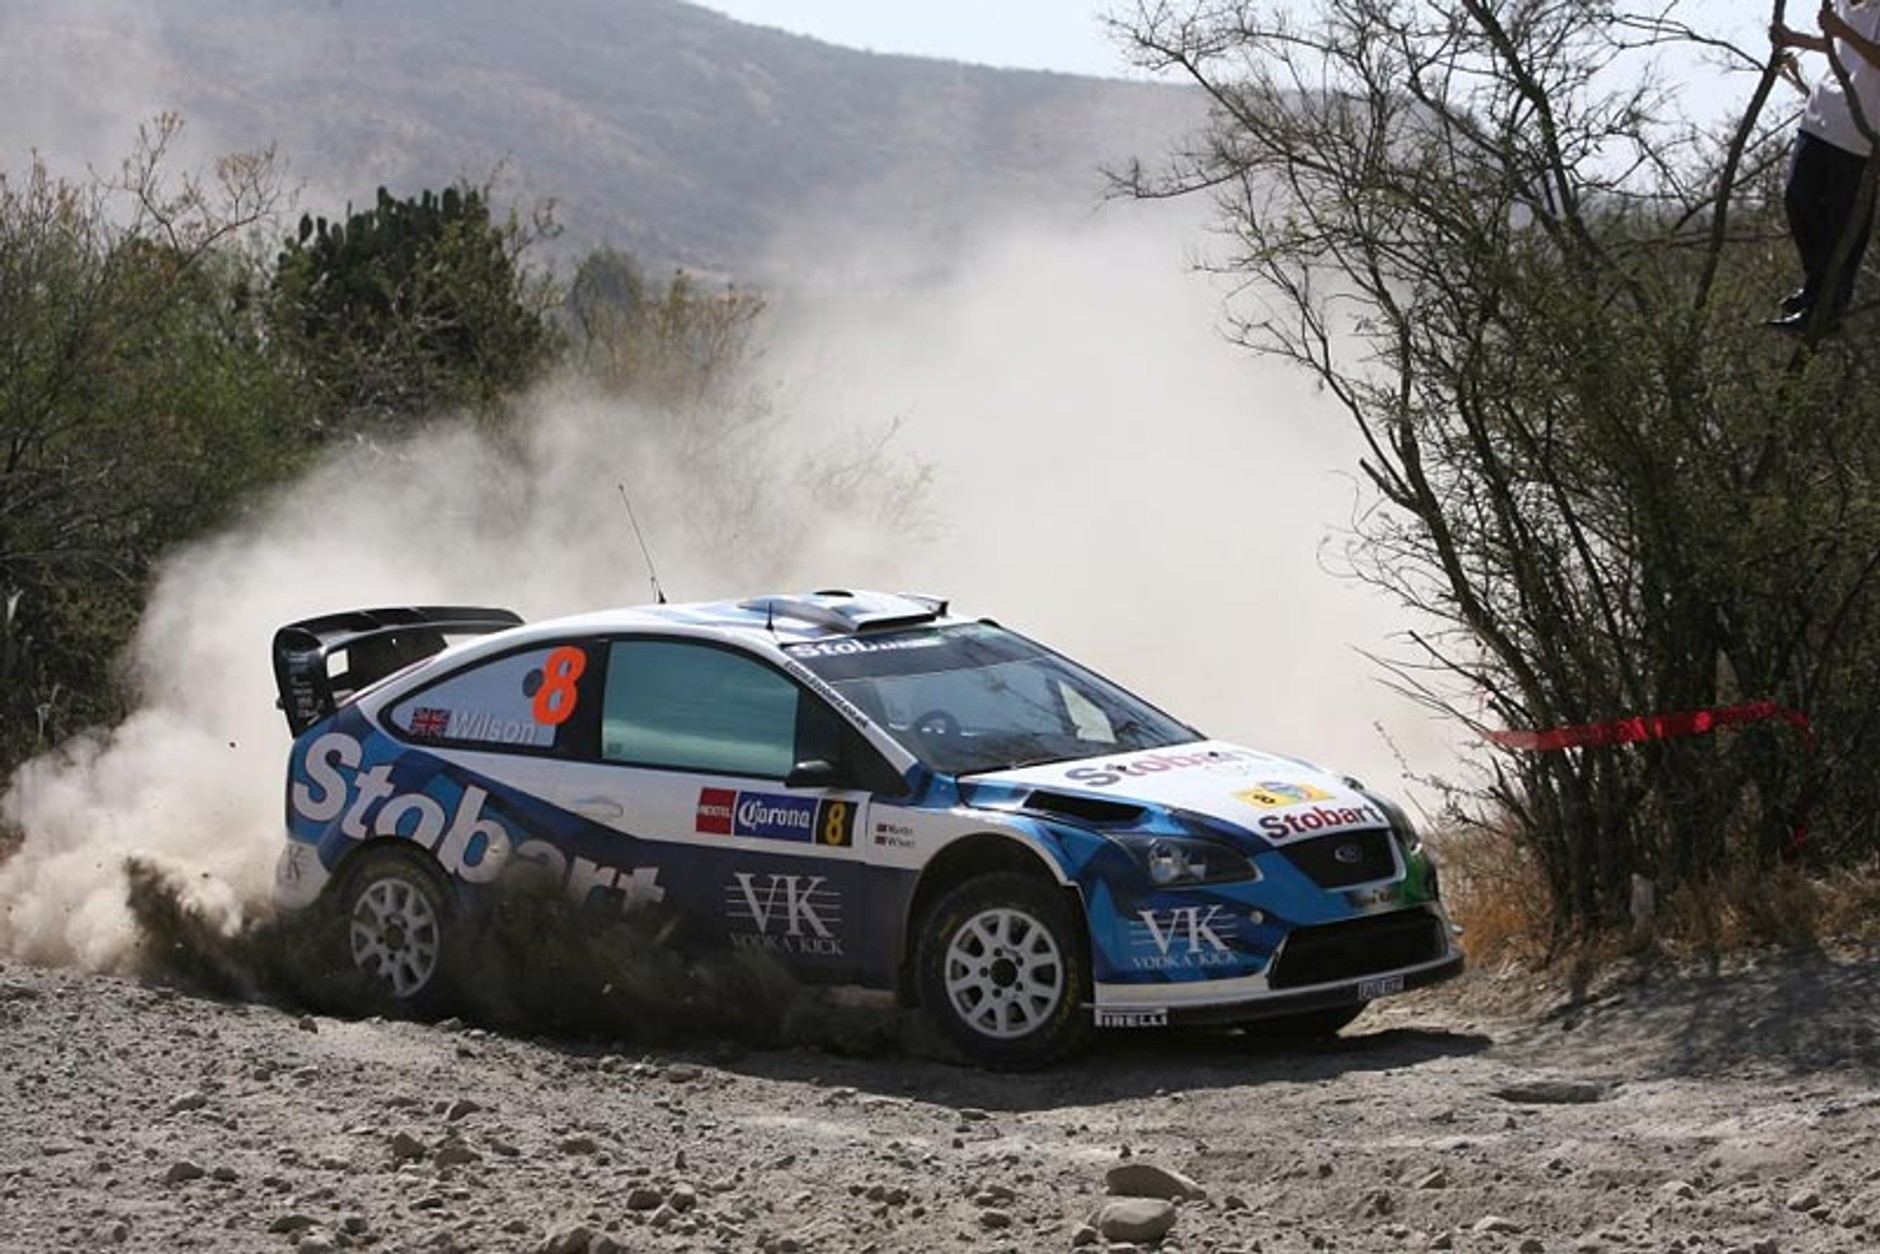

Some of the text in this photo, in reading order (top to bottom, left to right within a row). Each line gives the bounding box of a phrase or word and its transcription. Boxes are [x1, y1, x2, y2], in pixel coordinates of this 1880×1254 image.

[532, 646, 587, 725] 8
[450, 710, 538, 745] Wilson
[738, 799, 810, 830] Corona
[825, 802, 846, 845] 8
[1259, 804, 1384, 839] Stobart
[733, 872, 834, 938] VK
[1137, 904, 1230, 955] VK
[1132, 953, 1194, 970] VODKA
[1095, 1008, 1167, 1028] PIRELLI
